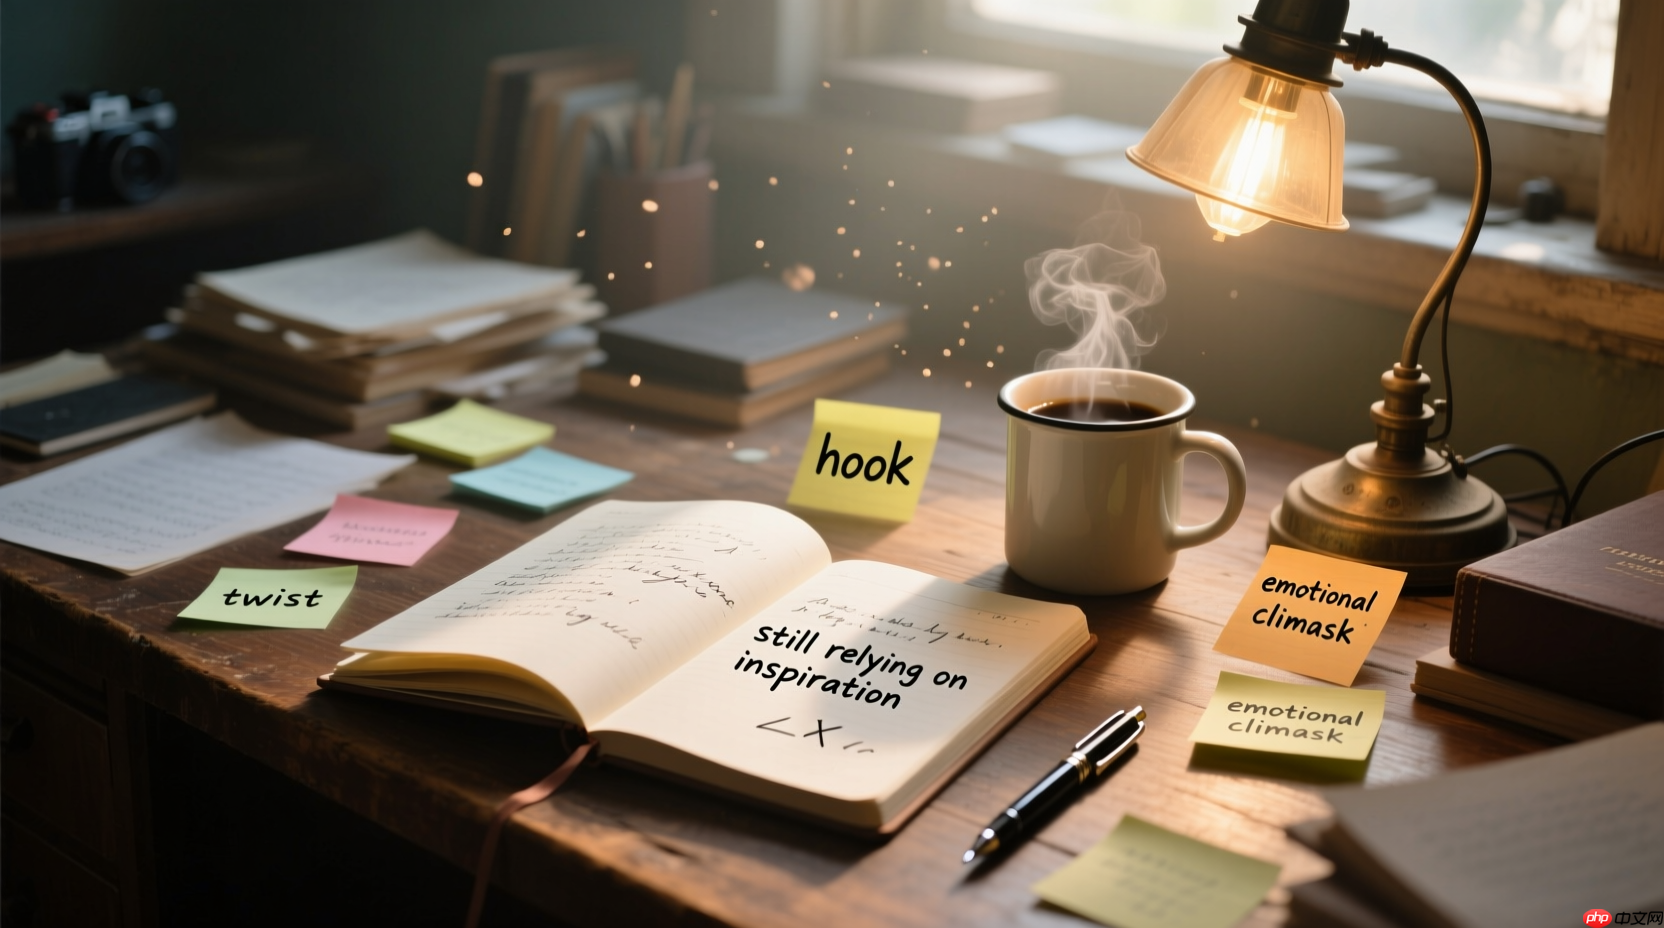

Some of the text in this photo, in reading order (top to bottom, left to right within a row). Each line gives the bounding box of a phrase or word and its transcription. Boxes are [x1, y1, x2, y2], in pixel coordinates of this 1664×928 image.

[815, 431, 914, 486] hook
[222, 588, 324, 608] twist
[1261, 576, 1378, 612] emotional
[1252, 603, 1355, 645] climask
[753, 624, 968, 691] still relying on
[734, 650, 902, 710] inspiration
[1227, 701, 1364, 727] emotional
[1228, 719, 1344, 744] climask
